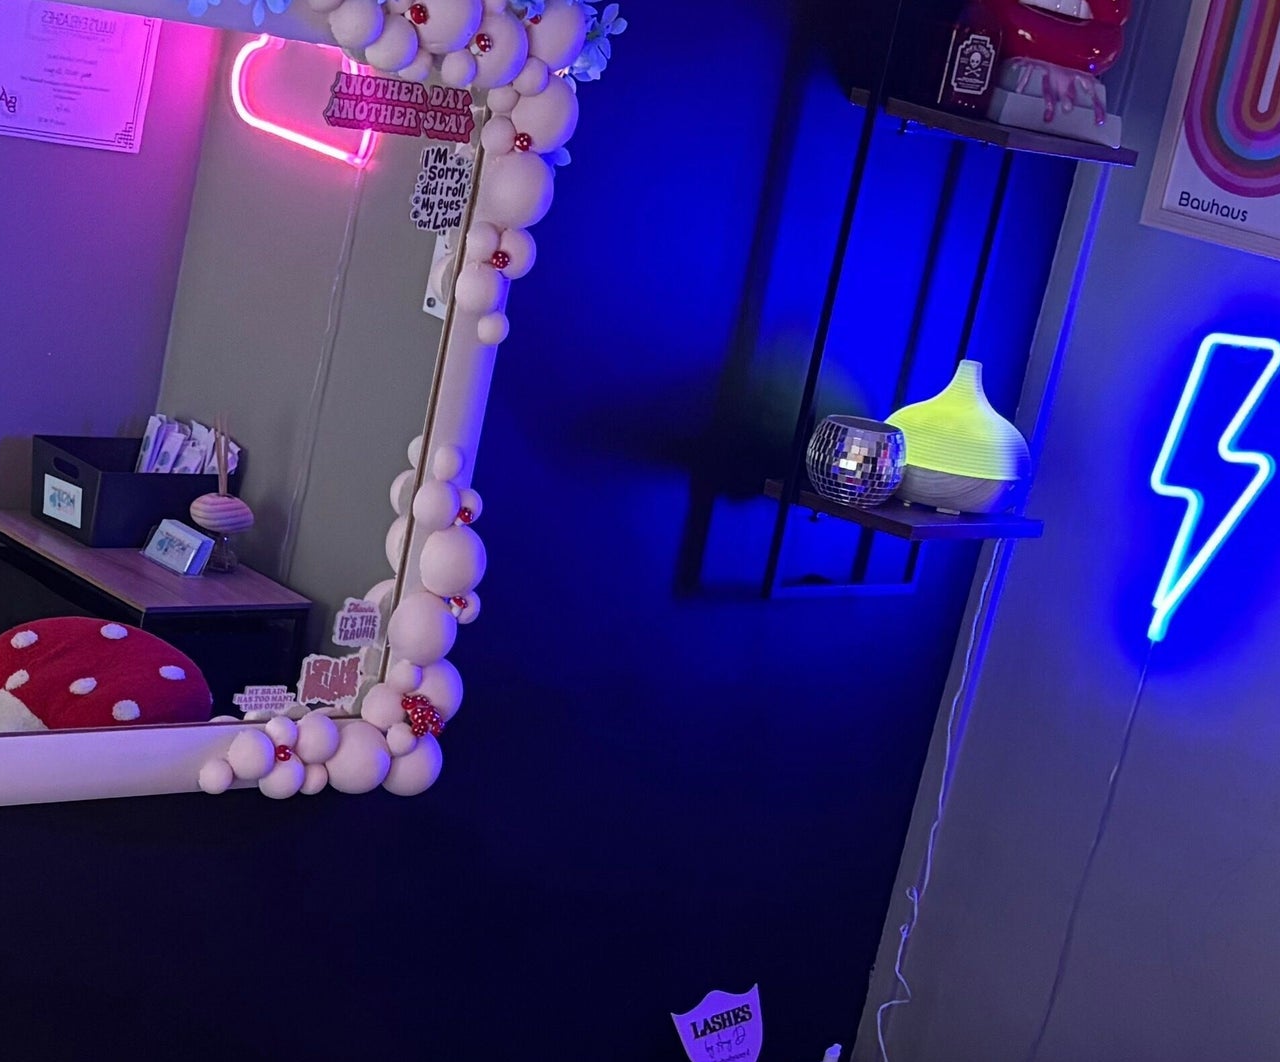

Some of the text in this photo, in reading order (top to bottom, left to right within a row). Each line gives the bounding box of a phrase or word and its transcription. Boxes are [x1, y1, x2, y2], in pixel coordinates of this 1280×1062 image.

[334, 74, 424, 104] ANOTHER
[326, 97, 470, 134] ANOTHER SLAY
[424, 147, 448, 168] I'M
[421, 181, 439, 195] did
[445, 182, 465, 198] roll
[438, 198, 461, 216] eyes
[1178, 190, 1248, 223] Bauhaus
[418, 218, 431, 229] out
[360, 615, 378, 628] THE
[339, 627, 376, 641] TRAUMA
[690, 1004, 753, 1039] LASHES
